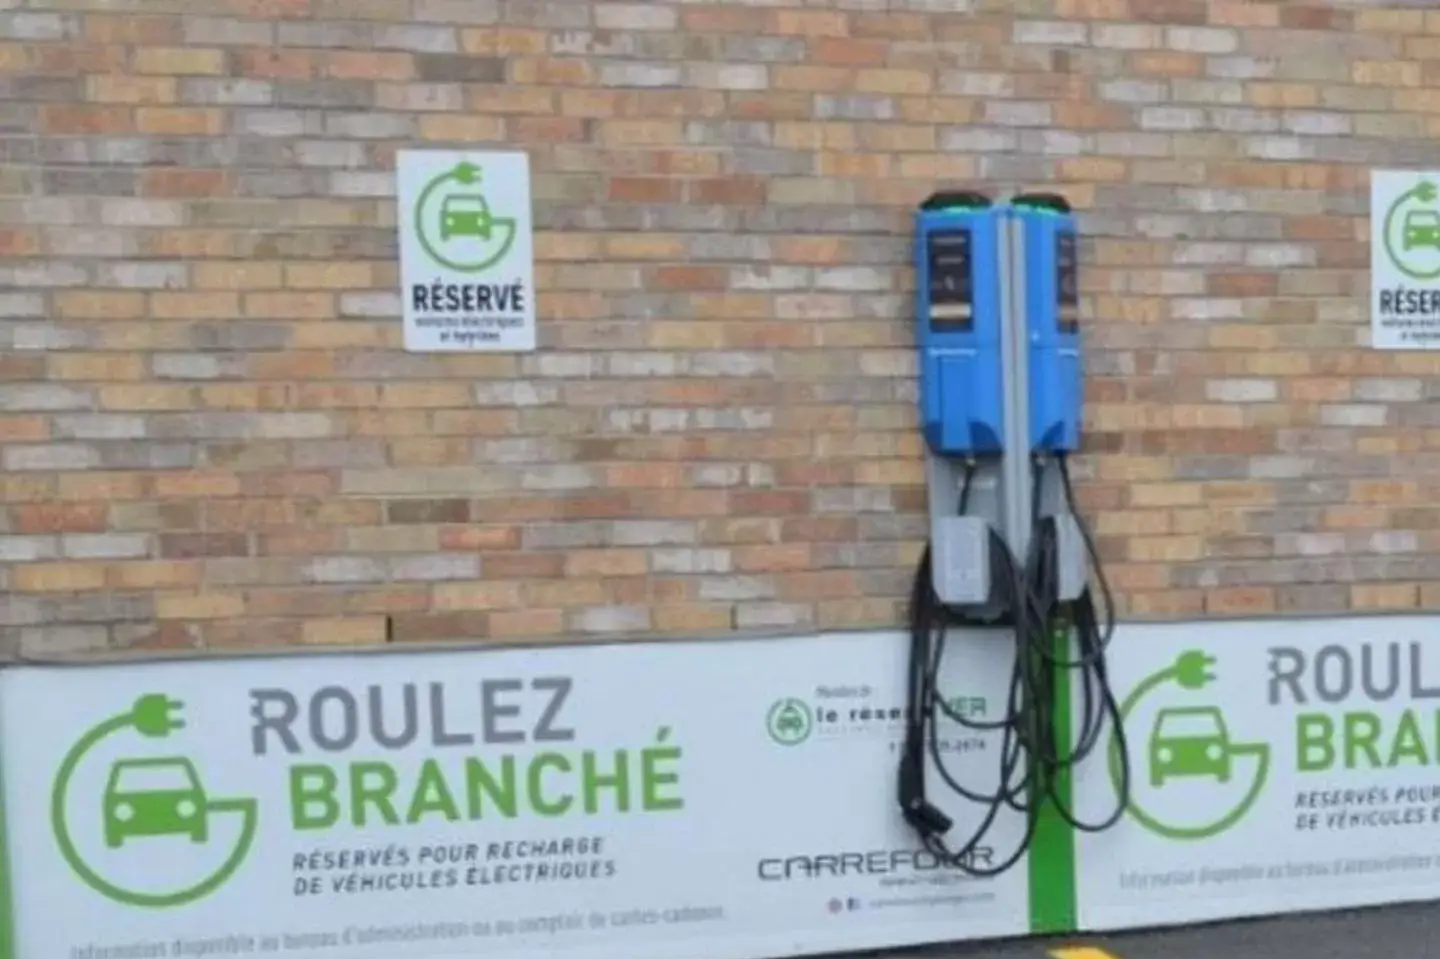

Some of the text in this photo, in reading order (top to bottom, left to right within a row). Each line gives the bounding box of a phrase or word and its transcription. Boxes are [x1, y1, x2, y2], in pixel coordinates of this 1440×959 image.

[412, 276, 525, 313] RÉSERVÉ
[249, 677, 576, 756] ROULEZ
[816, 705, 838, 723] le
[289, 726, 686, 831] BRANCHÉ
[1294, 812, 1319, 832] DE
[293, 836, 605, 872] RÉSERVÉS POUR RECHARGE
[293, 859, 617, 897] DE VÉHICULES ÉLECTRIQUES
